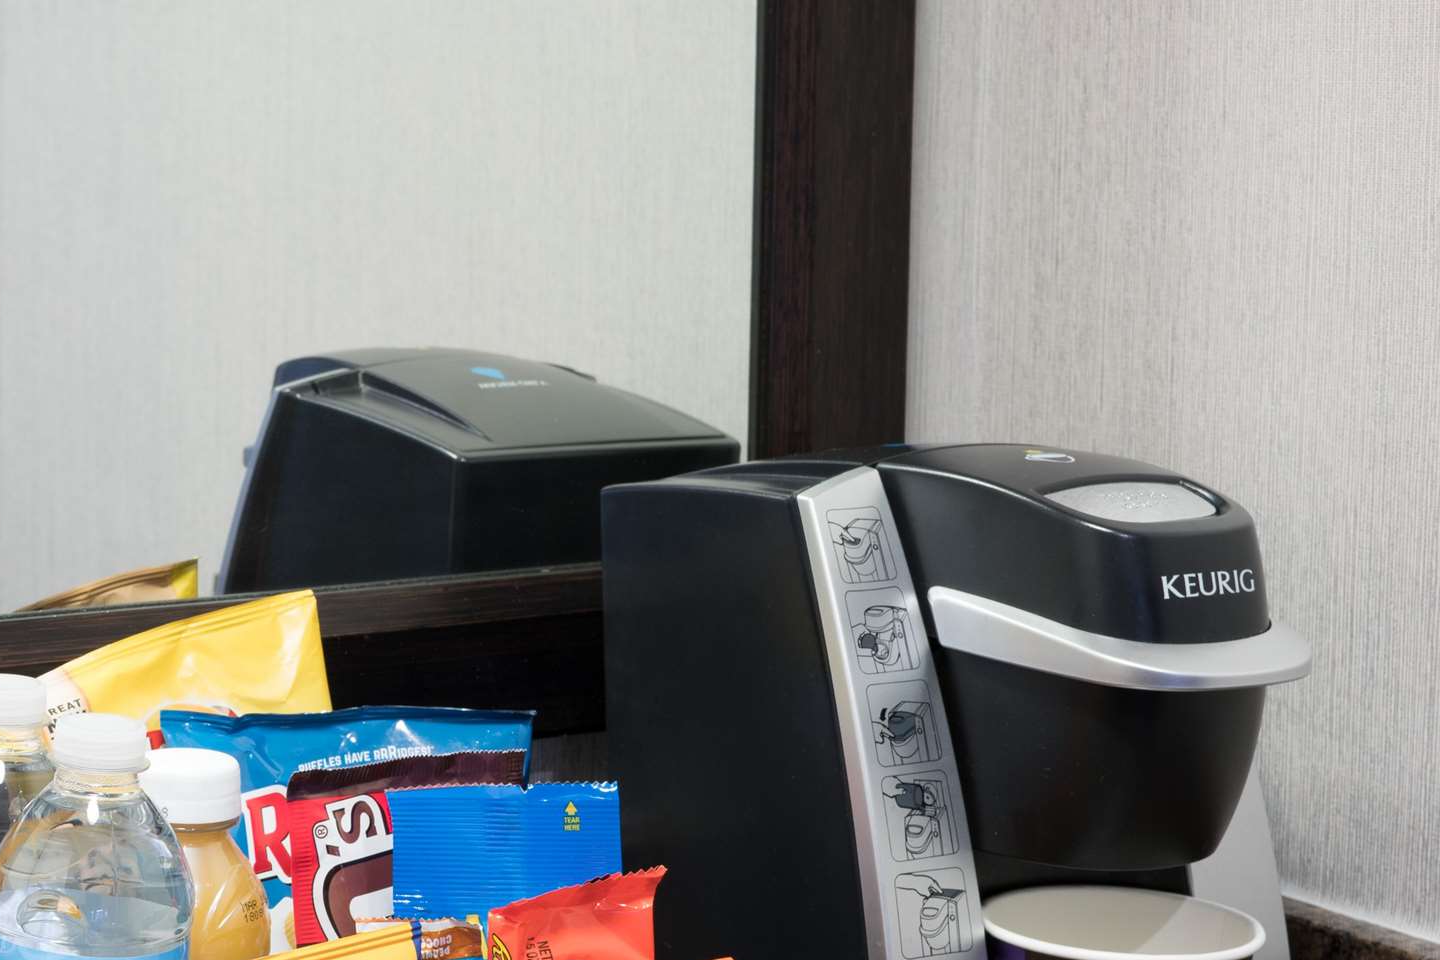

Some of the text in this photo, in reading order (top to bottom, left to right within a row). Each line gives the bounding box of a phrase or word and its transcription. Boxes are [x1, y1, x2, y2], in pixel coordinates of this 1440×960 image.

[1160, 568, 1256, 600] KEURIG
[47, 698, 82, 716] REAT
[298, 755, 342, 772] RUFFLES
[344, 750, 371, 765] HAVE
[564, 816, 580, 824] TEAR
